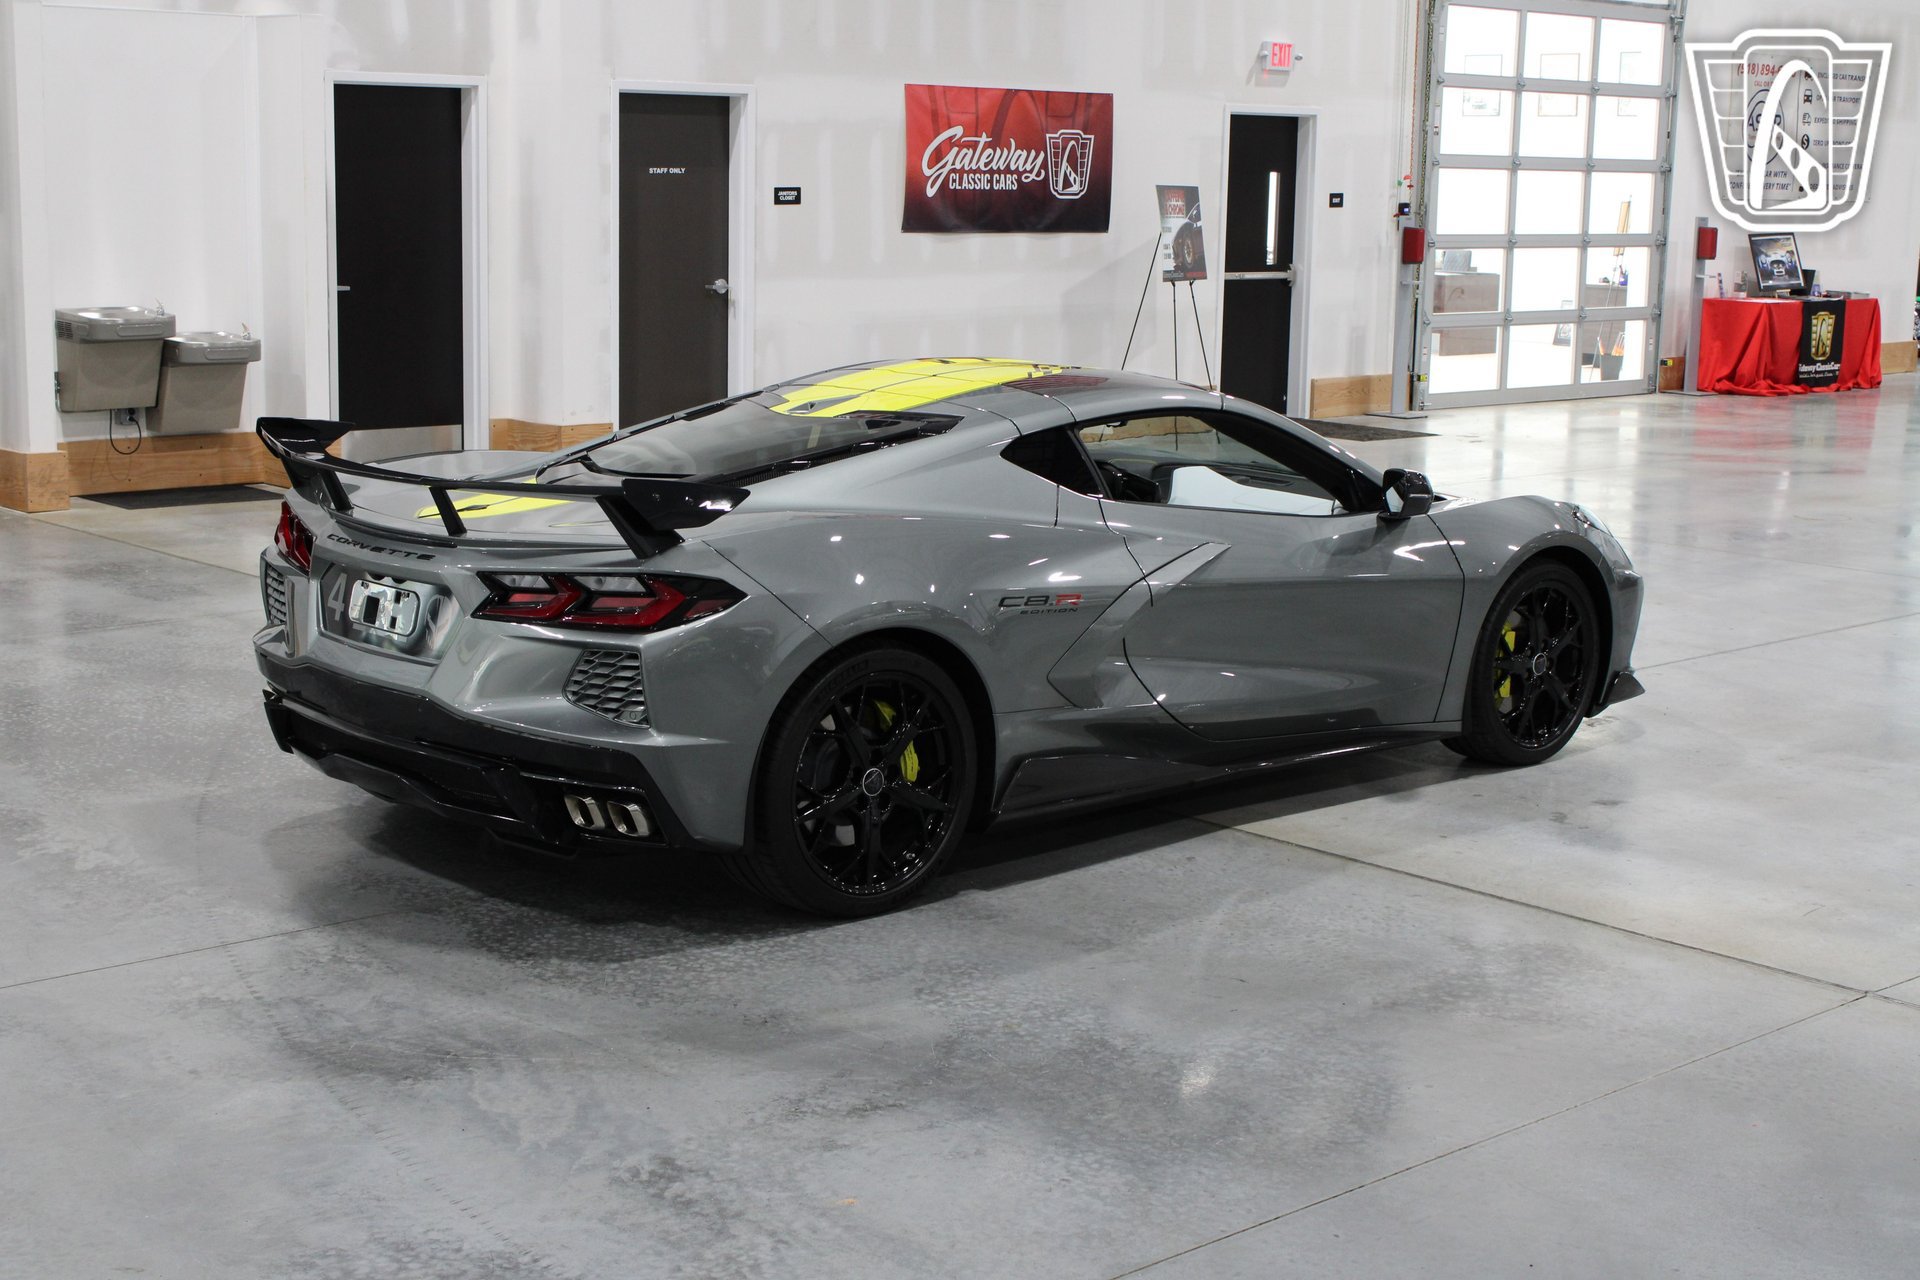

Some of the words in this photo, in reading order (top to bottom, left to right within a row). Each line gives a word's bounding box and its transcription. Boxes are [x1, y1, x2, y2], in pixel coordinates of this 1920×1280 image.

[1271, 42, 1293, 67] EXIT
[921, 125, 1045, 198] Gateway
[949, 173, 991, 190] CLASSIC
[993, 174, 1018, 191] CARS
[327, 533, 436, 561] CORVETTE
[1020, 607, 1079, 615] EDITION
